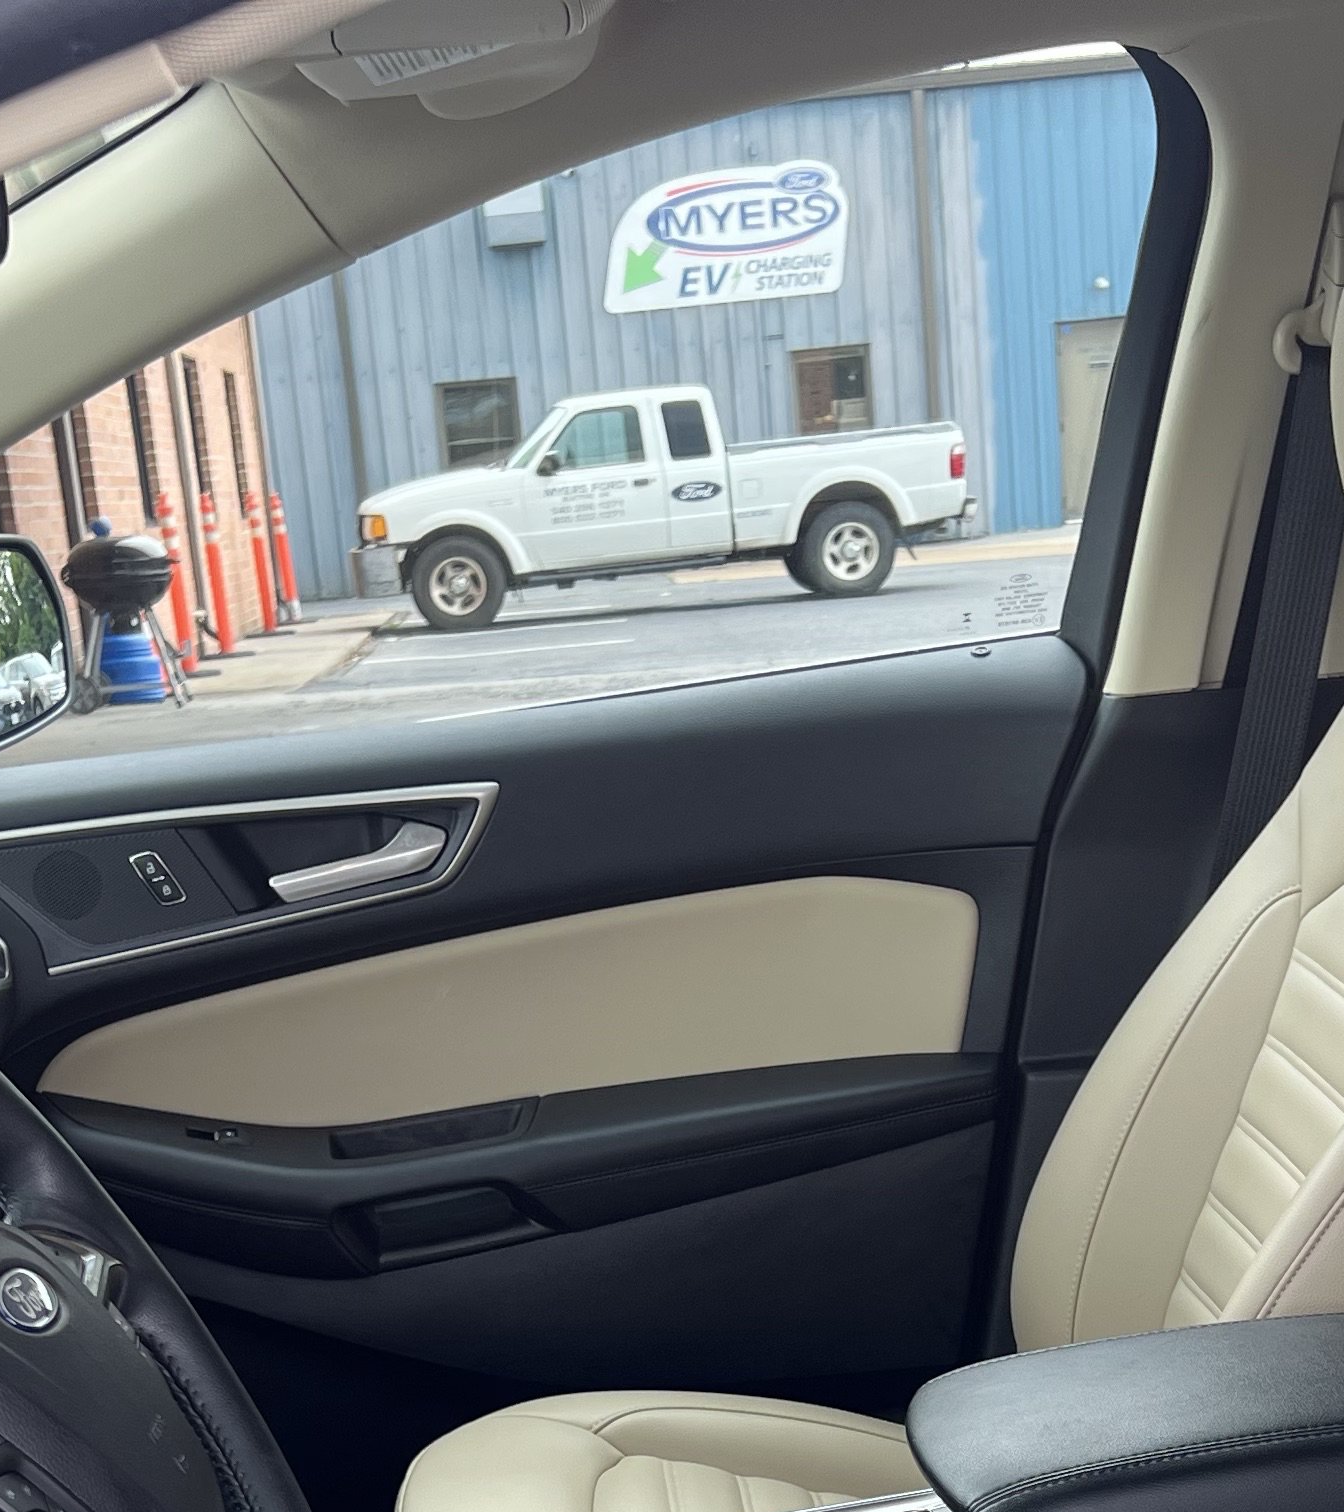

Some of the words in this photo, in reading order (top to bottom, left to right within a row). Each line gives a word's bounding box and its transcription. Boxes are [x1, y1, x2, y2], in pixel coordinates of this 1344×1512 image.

[784, 172, 819, 189] Ford
[660, 192, 828, 239] MYERS
[744, 252, 833, 275] CHARGING
[678, 262, 732, 299] EV
[754, 270, 826, 292] STATION
[678, 484, 715, 500] Ford
